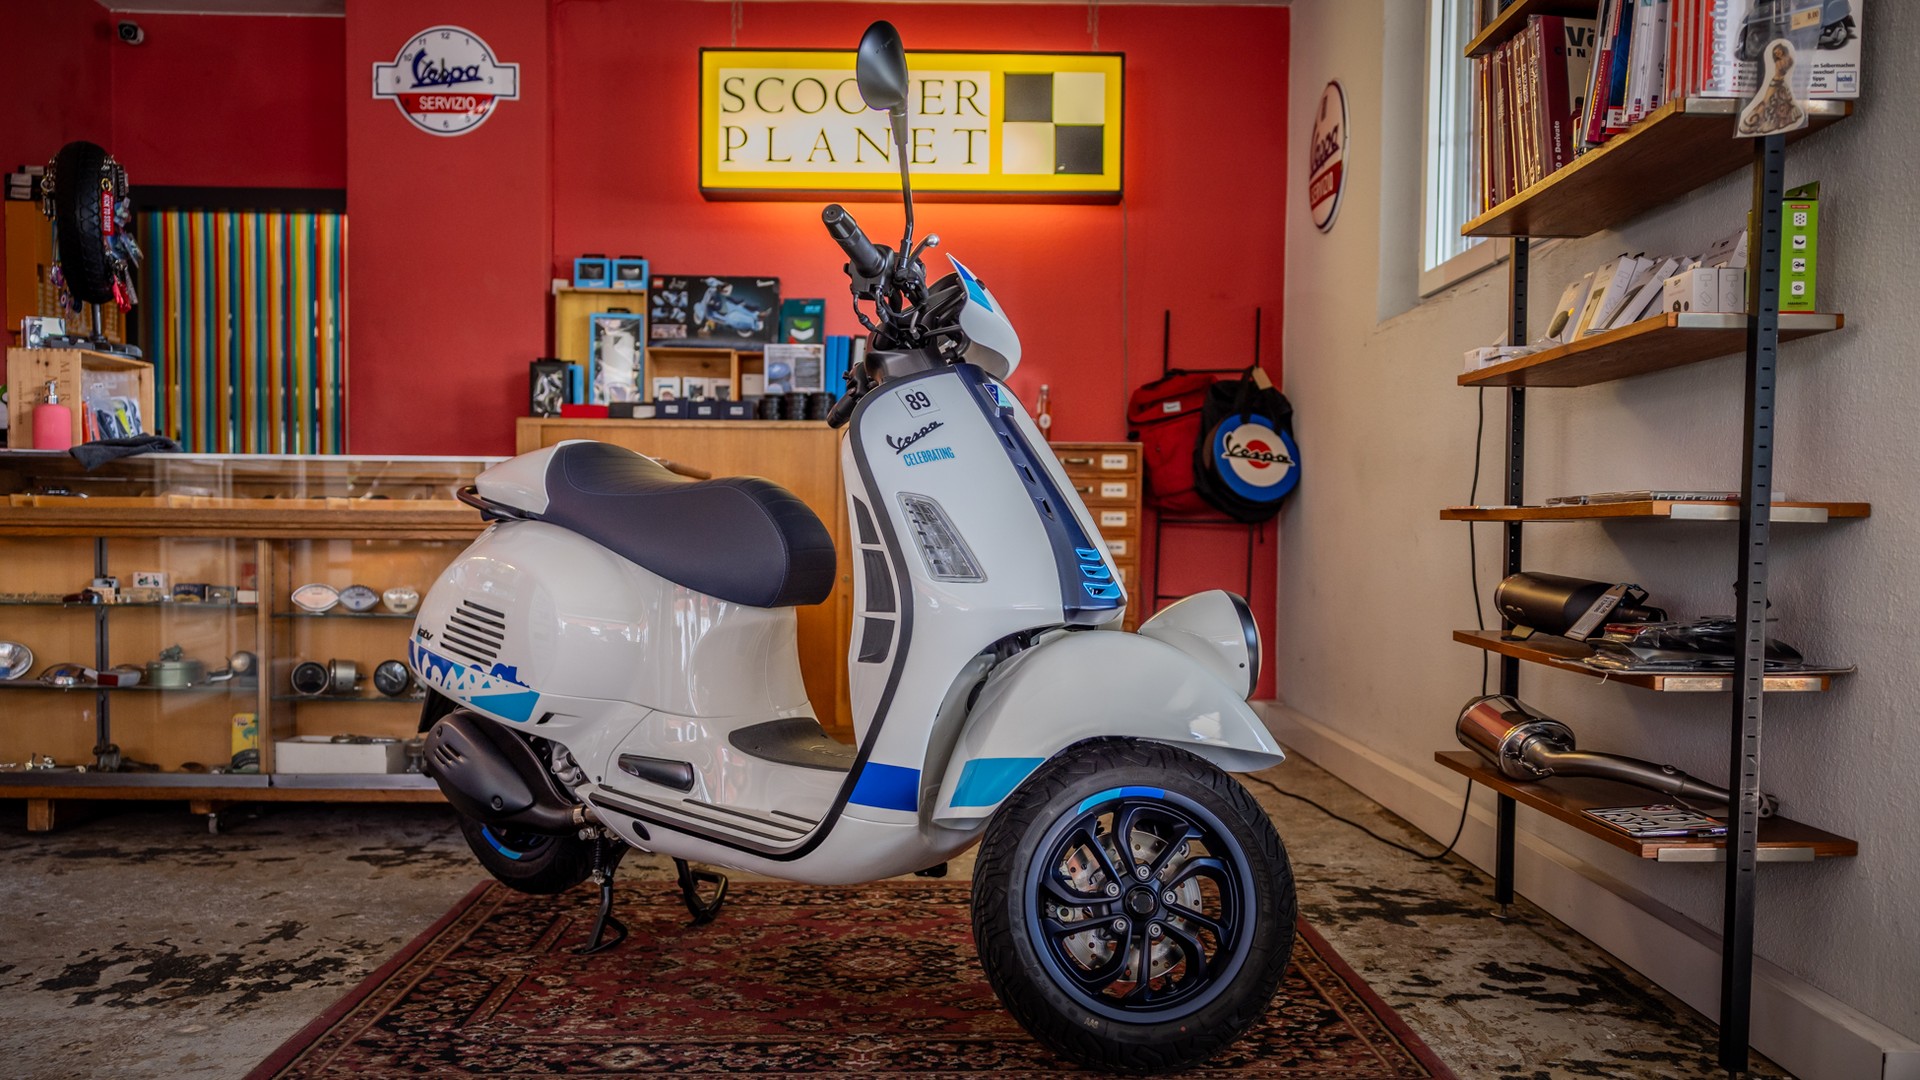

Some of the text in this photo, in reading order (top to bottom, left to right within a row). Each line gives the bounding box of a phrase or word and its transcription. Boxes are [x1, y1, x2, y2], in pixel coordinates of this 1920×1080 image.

[441, 32, 450, 40] 12
[418, 95, 476, 111] SERVIZIO
[721, 76, 988, 118] SCOOER
[721, 125, 988, 166] PLANET
[904, 391, 931, 411] 89
[886, 421, 944, 455] Vespa
[1224, 433, 1294, 465] Vespa
[903, 446, 955, 467] CELEBRATING
